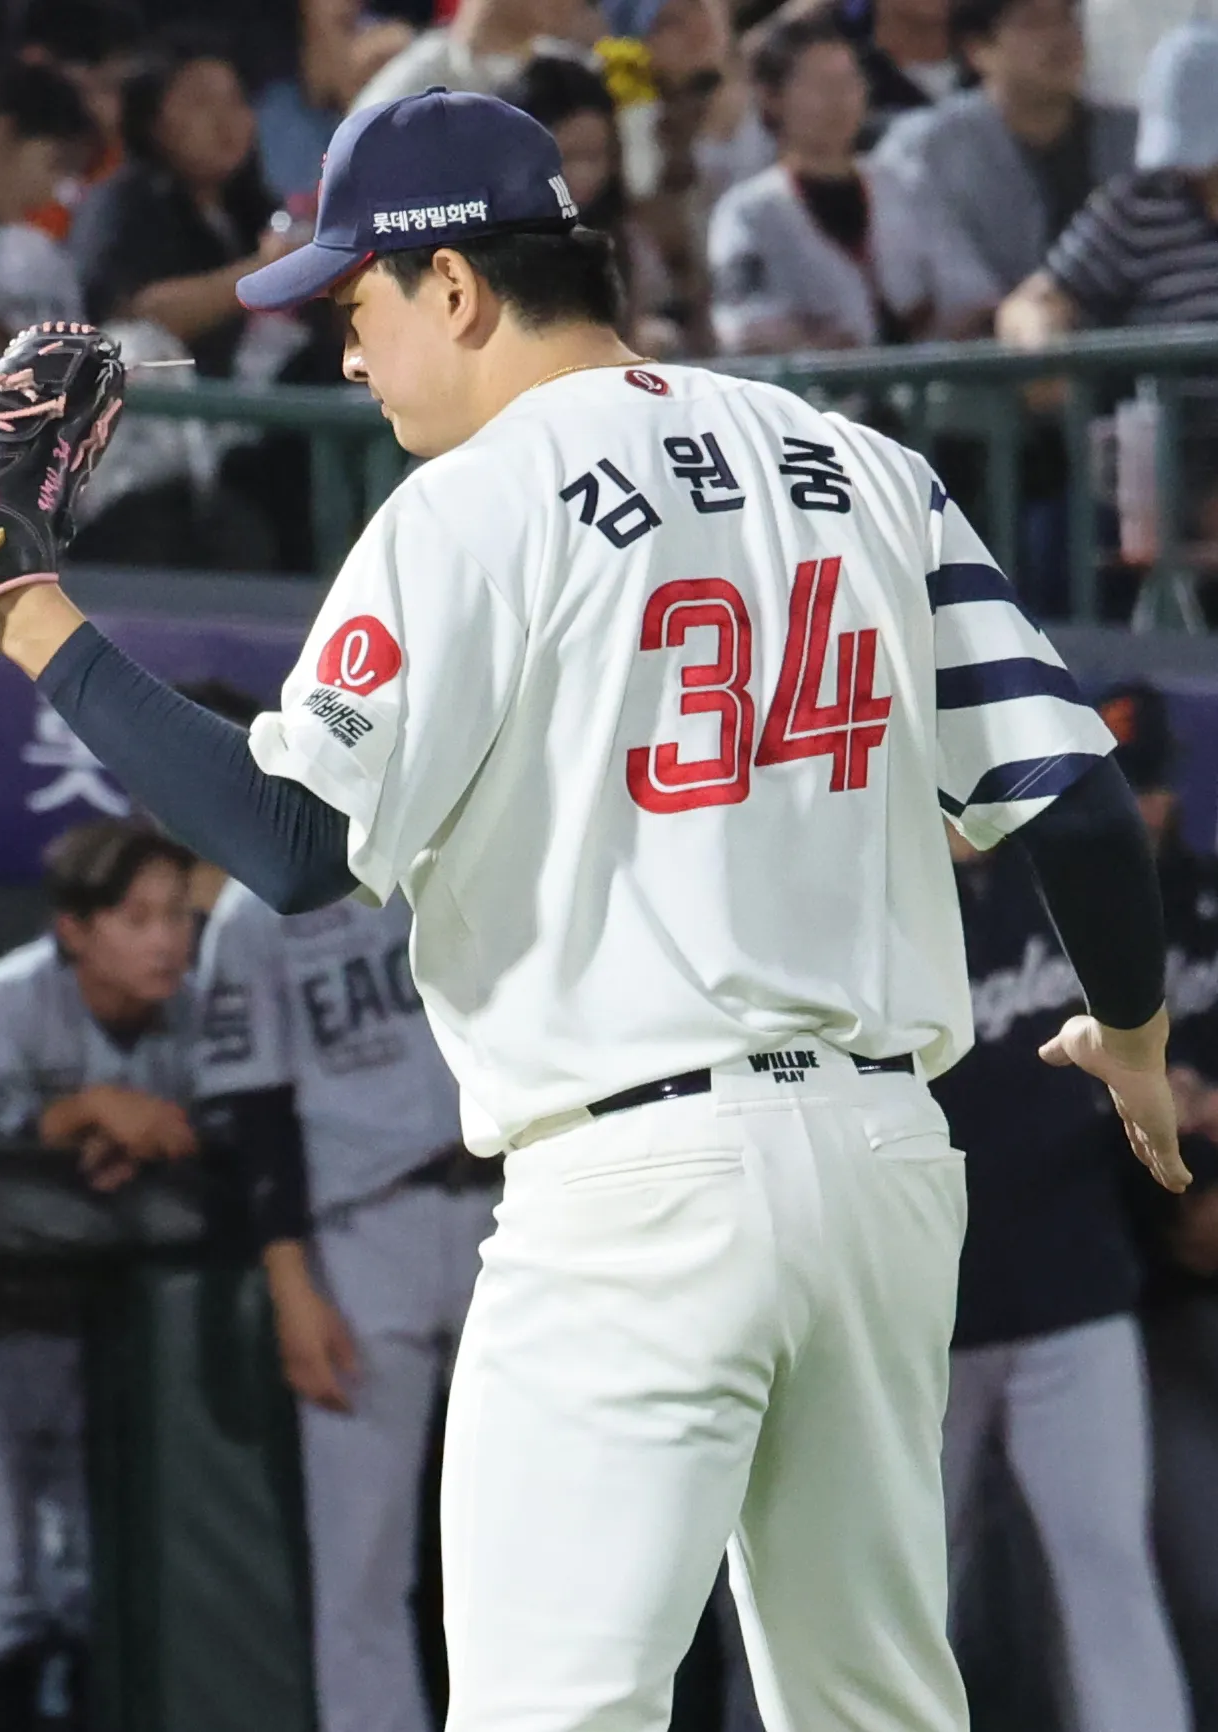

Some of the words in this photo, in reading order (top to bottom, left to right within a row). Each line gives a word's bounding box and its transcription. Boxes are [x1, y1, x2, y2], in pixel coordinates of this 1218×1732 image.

[373, 200, 487, 234] 롯데정밀화학
[559, 431, 852, 549] 김원중
[625, 556, 892, 815] 34
[301, 687, 374, 741] 빼빼로
[747, 1050, 821, 1073] WILLBE
[773, 1070, 805, 1084] PLAY
